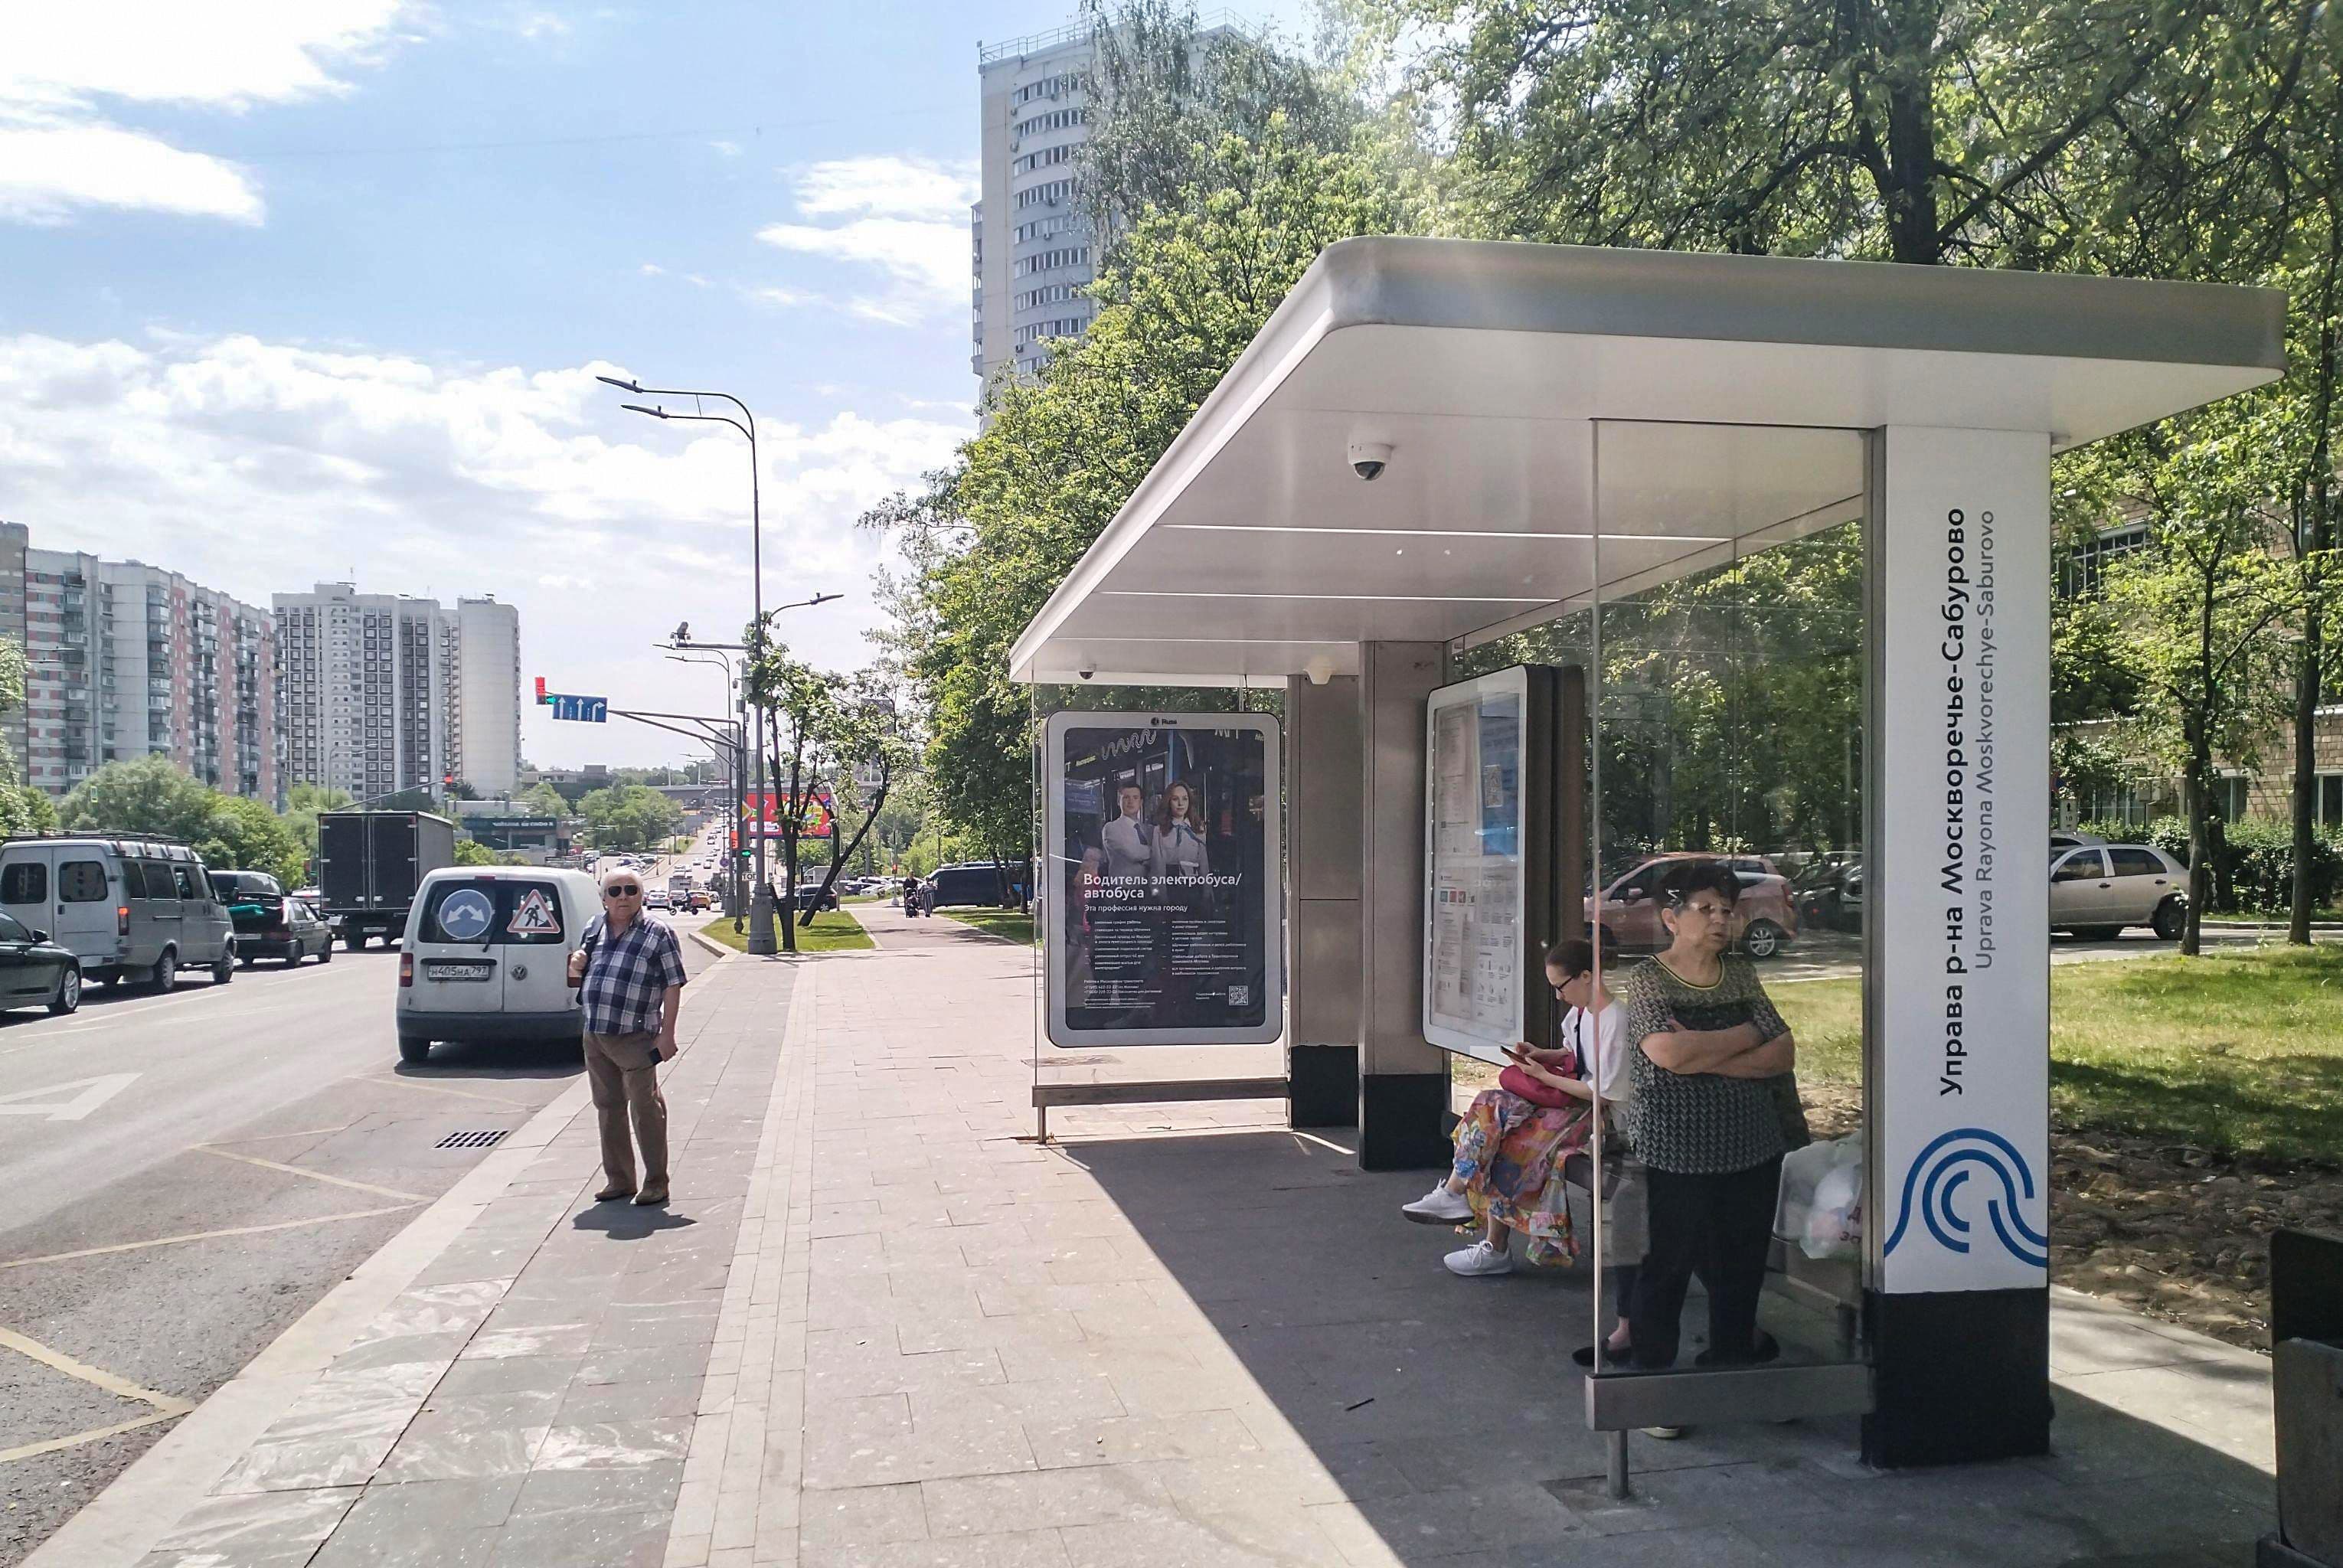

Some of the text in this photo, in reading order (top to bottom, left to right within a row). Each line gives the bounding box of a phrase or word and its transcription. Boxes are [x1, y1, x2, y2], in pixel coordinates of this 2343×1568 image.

[1975, 511, 1998, 969] Uprava Rayona Moskvorechye-Saburovo
[1939, 508, 1970, 1097] Управа р-на Москворечье-Сабурово
[1083, 873, 1242, 887] Водитель электробуса/
[1083, 887, 1144, 900] автобуса
[1097, 903, 1137, 913] профессия
[1139, 904, 1162, 913] нужна
[1162, 905, 1188, 913] городу
